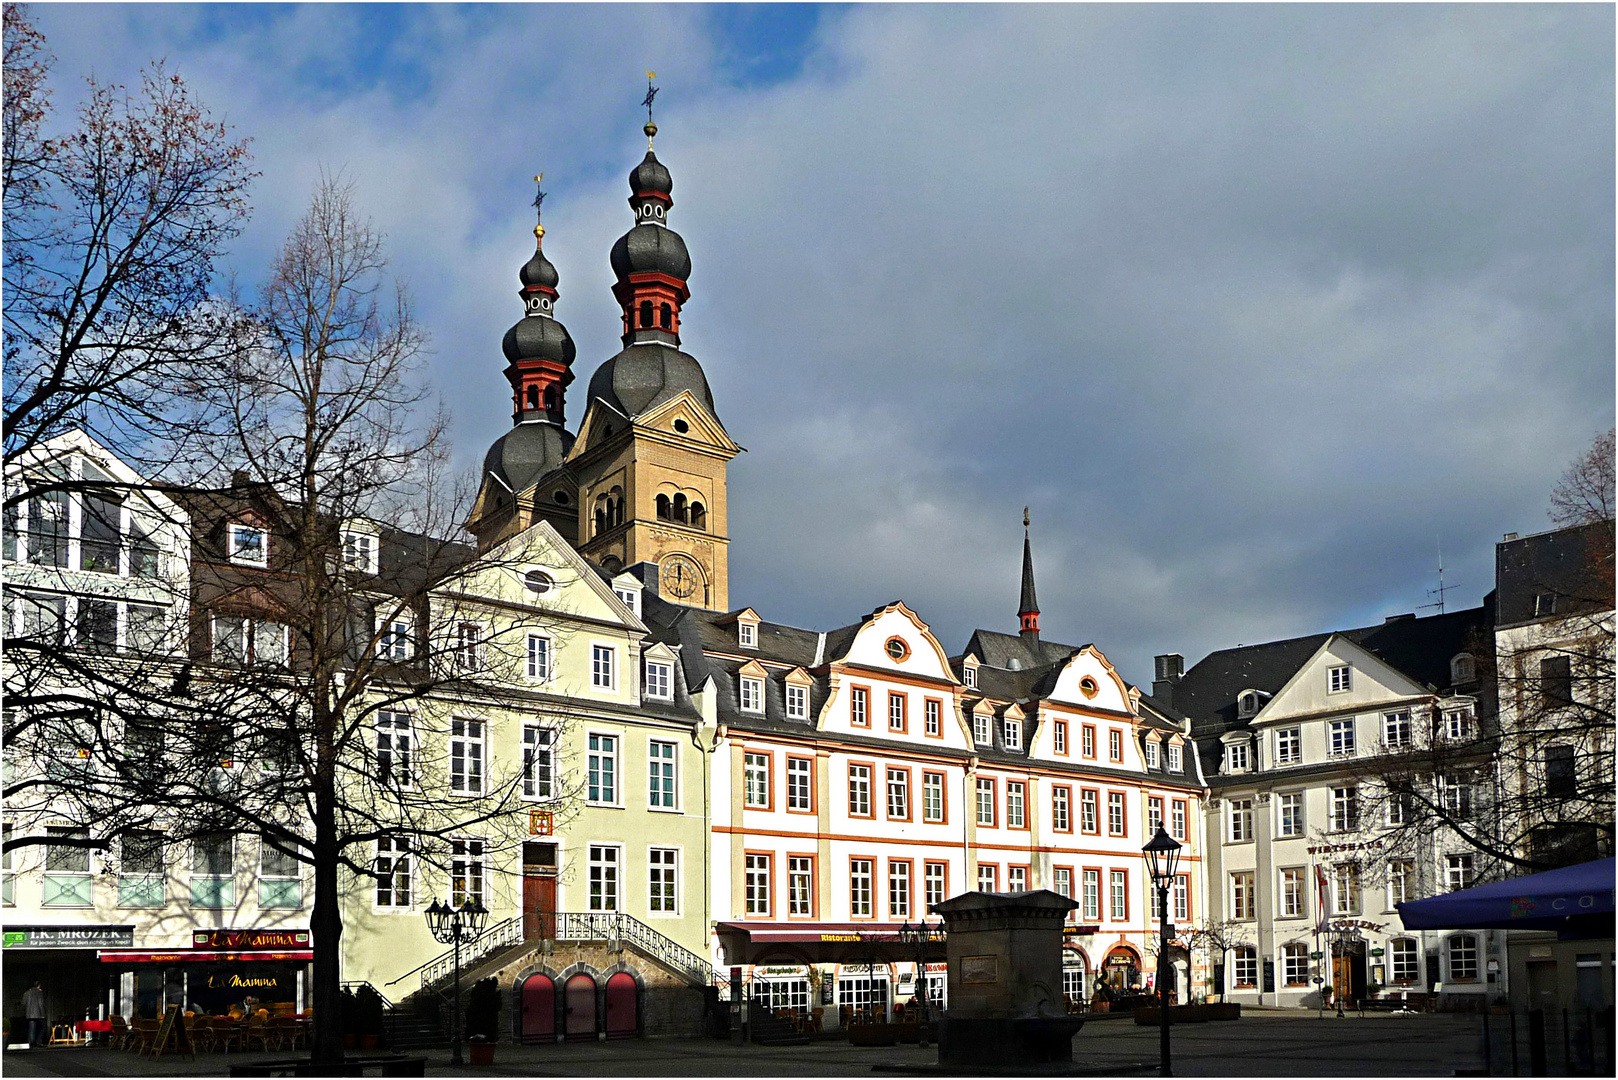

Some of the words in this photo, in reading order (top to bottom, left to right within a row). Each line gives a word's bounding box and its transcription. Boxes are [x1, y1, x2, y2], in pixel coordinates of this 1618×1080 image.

[1306, 841, 1383, 855] WIRTSHAUS
[58, 927, 121, 939] MROZEK
[1332, 920, 1383, 933] COBLENZ
[210, 931, 233, 947] La
[235, 931, 294, 946] Mamma
[821, 933, 861, 942] Ristorante
[228, 974, 278, 988] Mamma
